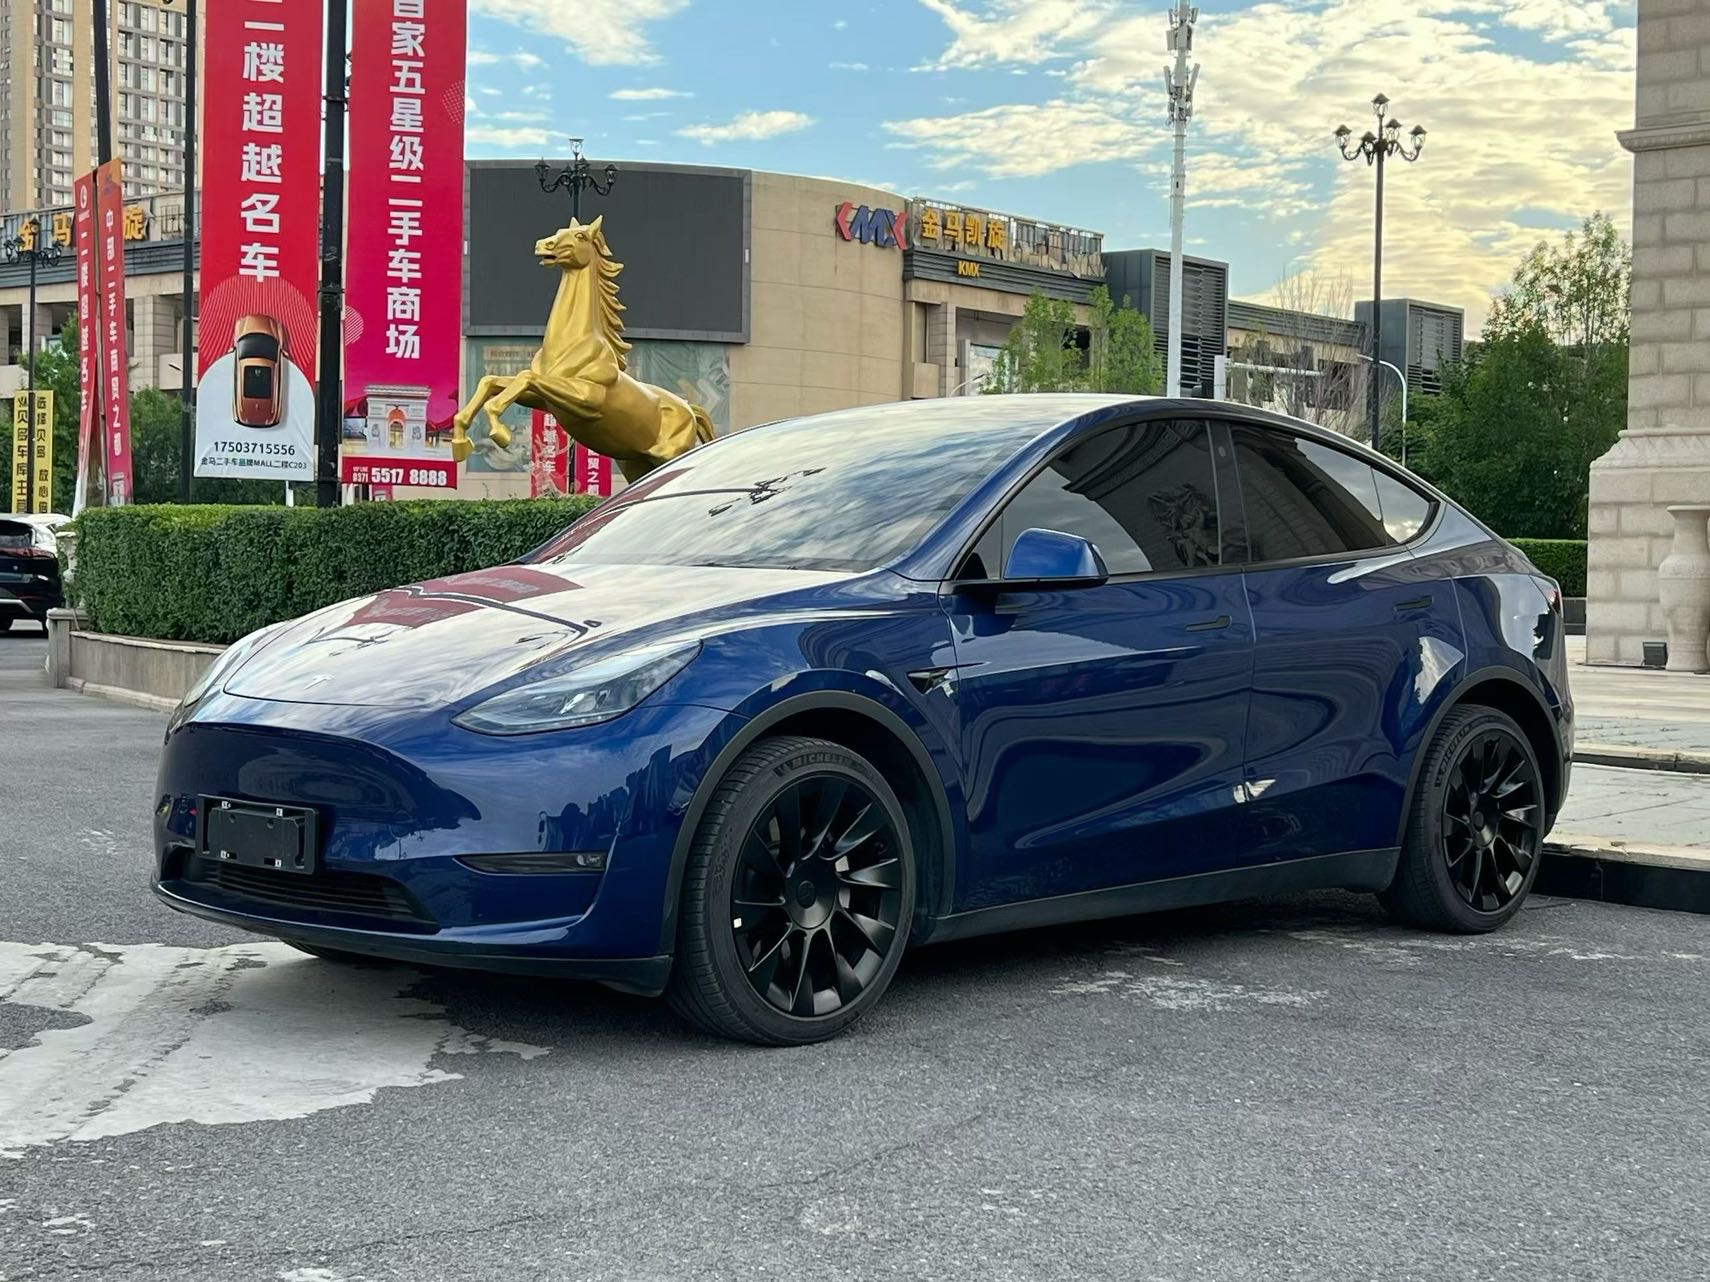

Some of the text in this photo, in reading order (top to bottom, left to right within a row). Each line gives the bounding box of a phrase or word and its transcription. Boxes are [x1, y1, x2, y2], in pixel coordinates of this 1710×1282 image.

[240, 0, 285, 282] 二楼超越名车
[920, 208, 1006, 250] 金马凯旋
[957, 260, 980, 277] KMX
[214, 441, 296, 456] 17503715556
[371, 467, 404, 484] 5517
[409, 469, 448, 486] 8888
